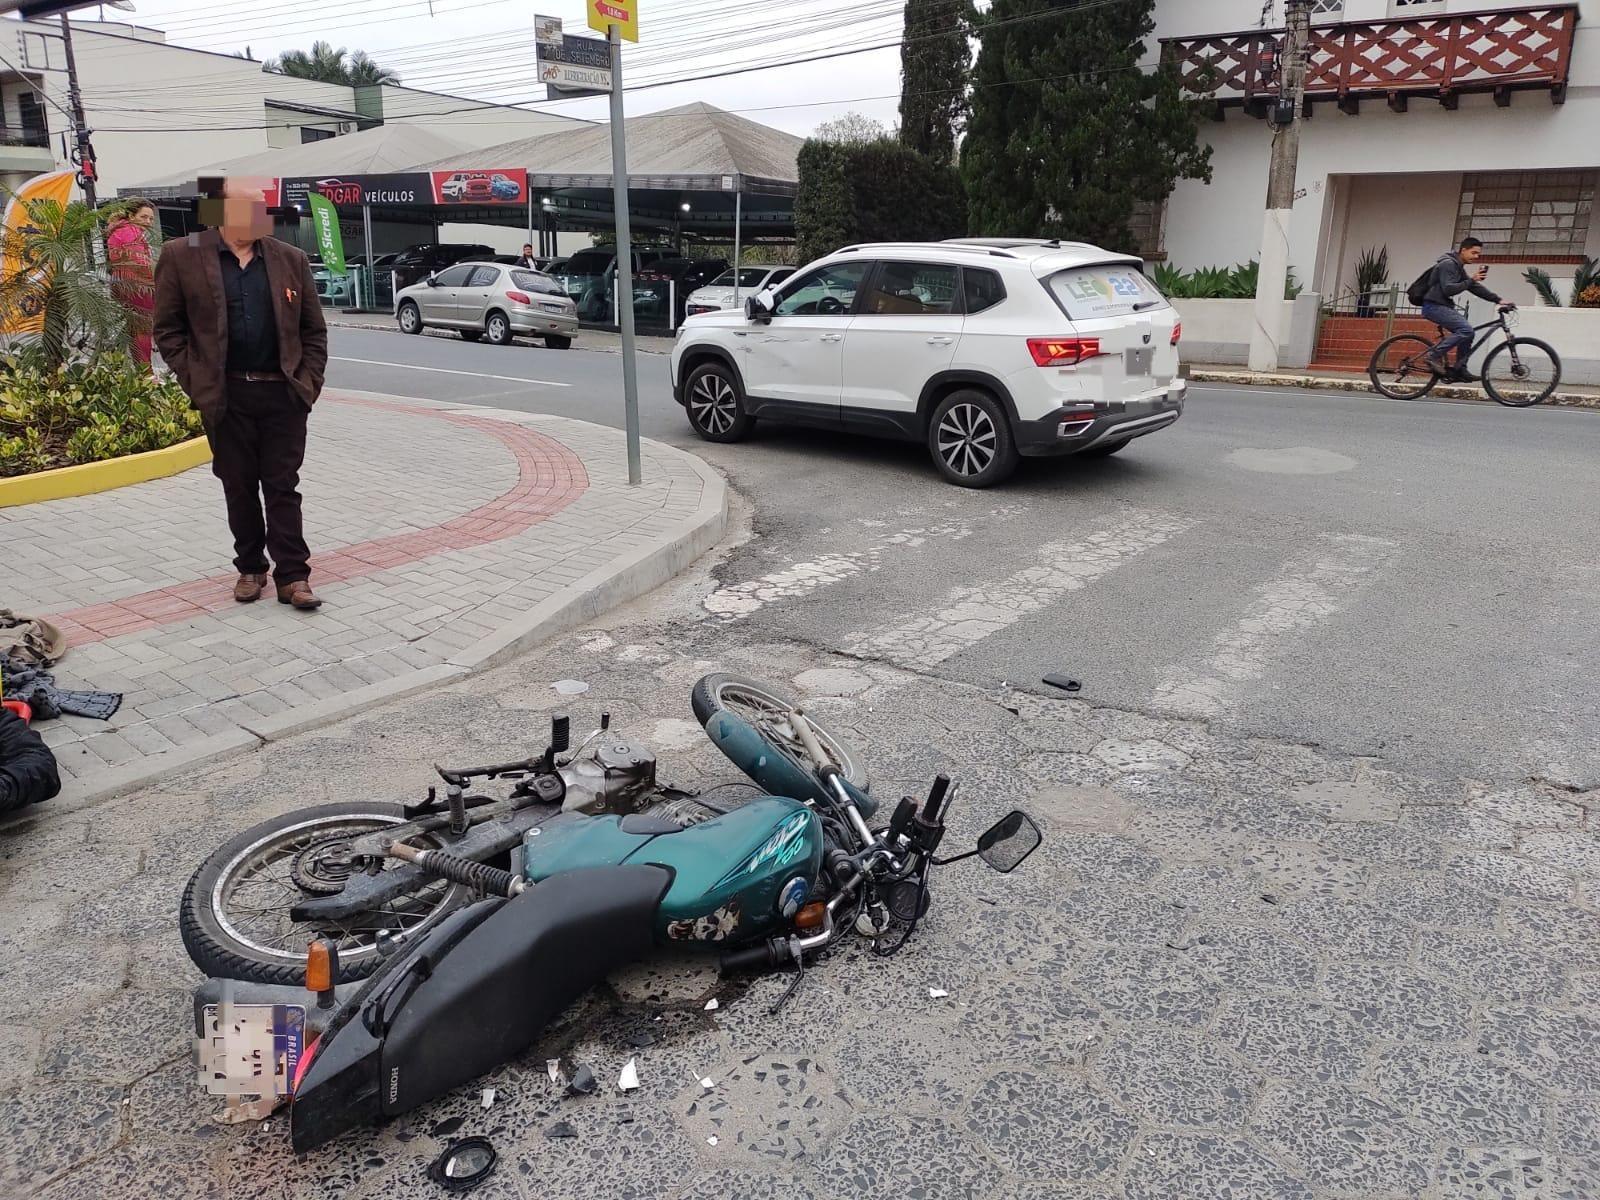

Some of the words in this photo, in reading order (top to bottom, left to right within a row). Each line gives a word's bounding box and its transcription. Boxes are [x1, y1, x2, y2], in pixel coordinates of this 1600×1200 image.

[576, 40, 594, 51] RUA
[555, 49, 566, 60] DE
[571, 51, 610, 66] SETEMBRO
[364, 189, 415, 202] VEÍCULOS
[318, 207, 334, 249] Sicredi
[1108, 277, 1140, 296] 22
[287, 1035, 298, 1067] BRASIL
[390, 1066, 399, 1105] HONDA
